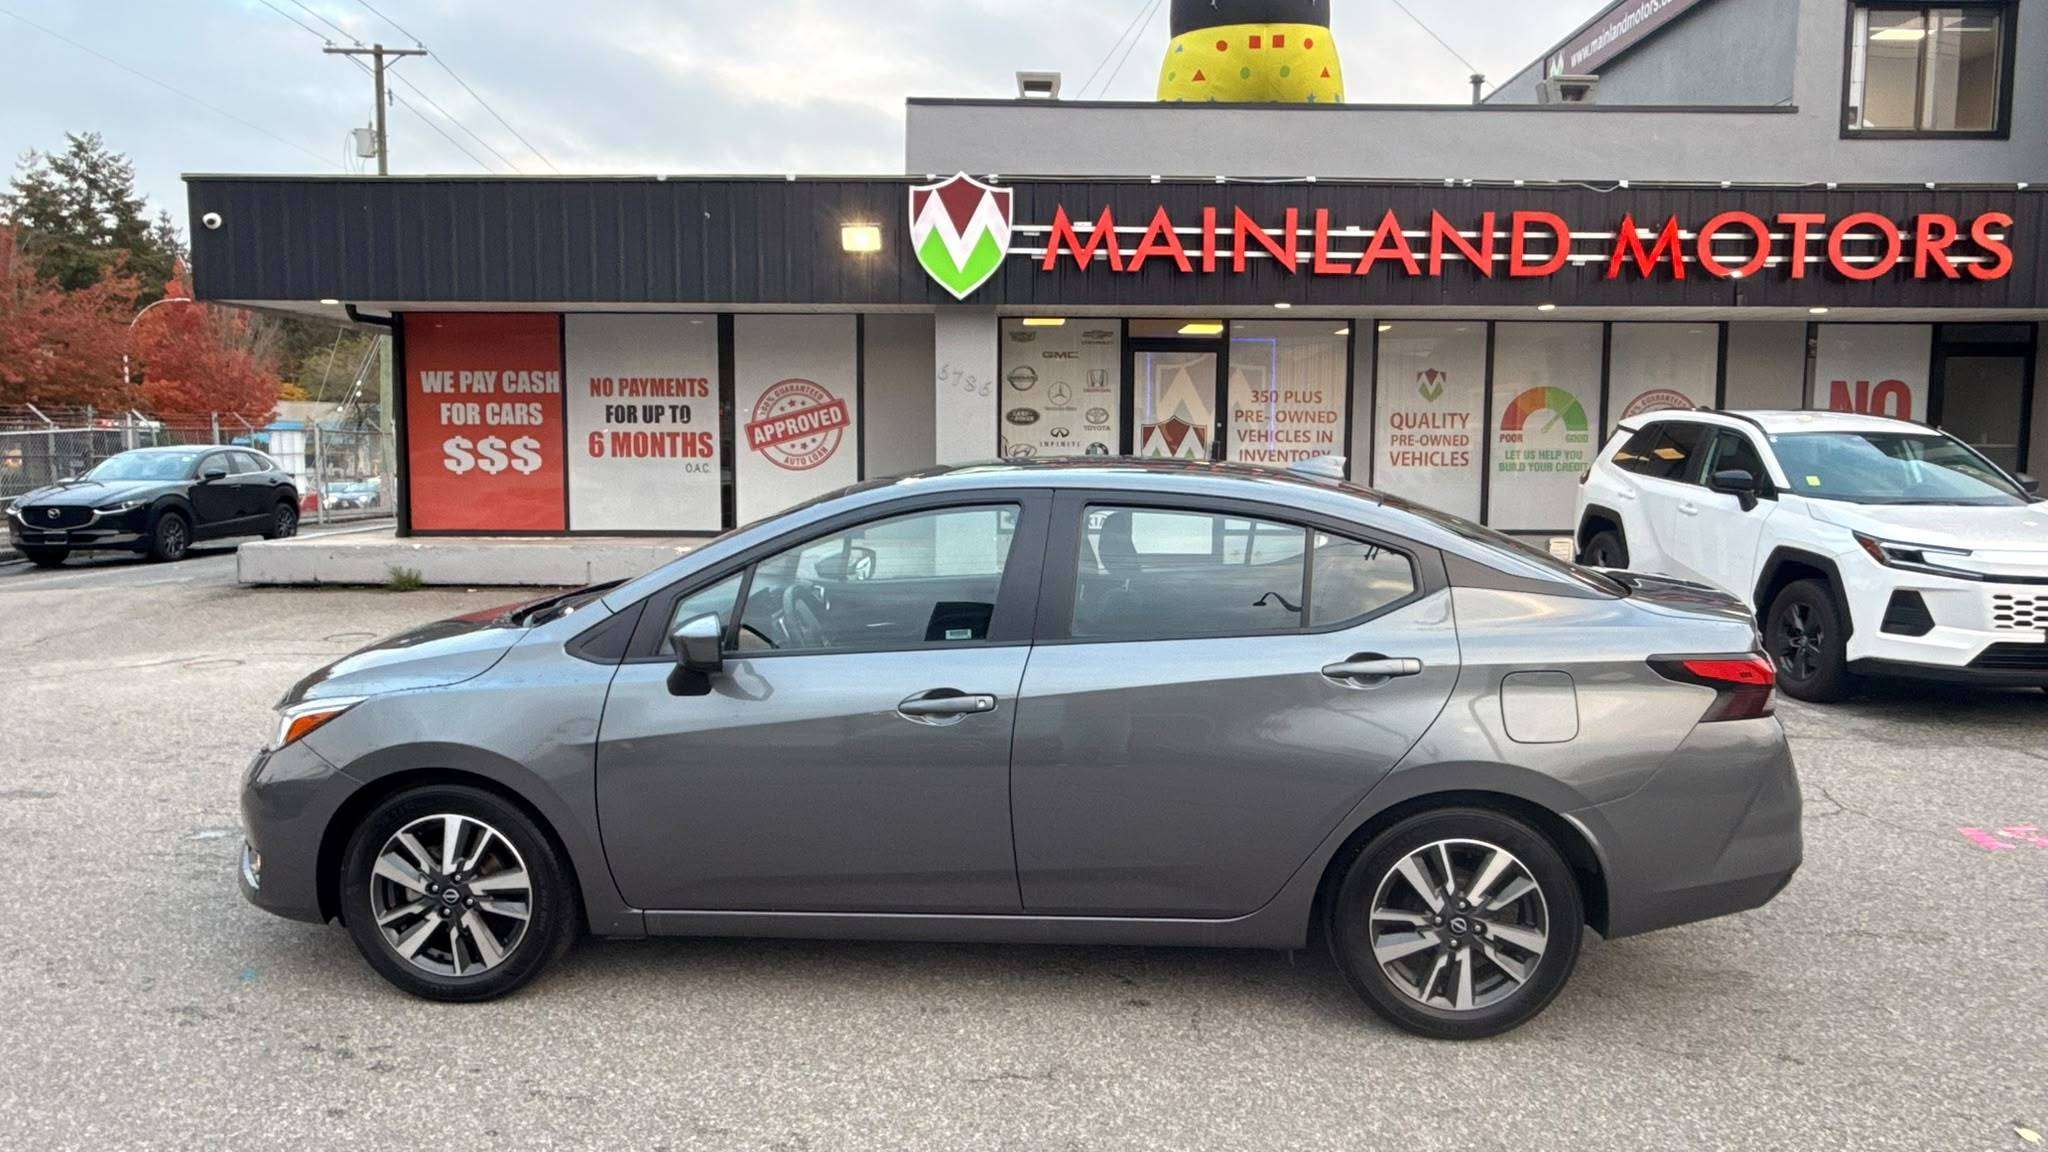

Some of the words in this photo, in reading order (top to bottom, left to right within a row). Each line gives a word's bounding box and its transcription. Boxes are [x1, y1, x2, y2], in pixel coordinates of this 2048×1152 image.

[1042, 204, 1571, 278] MAINLAND
[1607, 210, 2014, 280] MOTORS
[1042, 350, 1079, 360] GMC
[420, 371, 454, 393] WE
[459, 371, 498, 393] PAY
[502, 371, 560, 393] CASH
[590, 377, 613, 397] NO
[618, 377, 709, 397] PAYMENTS
[1251, 390, 1279, 403] 350
[1284, 390, 1322, 403] PLUS
[440, 402, 481, 425] FOR
[485, 402, 543, 425] CARS
[605, 404, 638, 423] FOR
[642, 404, 665, 423] UP
[668, 404, 691, 423] TO
[1275, 410, 1338, 423] OWNED
[1390, 412, 1470, 430] QUALITY
[753, 405, 842, 445] APPROVED
[588, 431, 605, 458] 6
[611, 431, 714, 458] MONTHS
[1237, 430, 1311, 443] VEHICLES
[1316, 430, 1333, 443] IN
[1391, 434, 1469, 446] PRE-OWNED
[1500, 433, 1523, 443] POOR
[1566, 433, 1588, 443] GOOD
[443, 435, 542, 475] $$$
[784, 456, 807, 465] AUTO
[808, 446, 829, 464] LOAN
[1390, 451, 1469, 467] VEHICLES
[1505, 450, 1521, 460] LET
[1523, 450, 1535, 460] US
[1539, 450, 1561, 460] HELP
[1564, 450, 1583, 460] YOU
[1499, 462, 1525, 472] BUILD
[1528, 462, 1553, 472] YOUR
[1556, 462, 1588, 472] CREDIT
